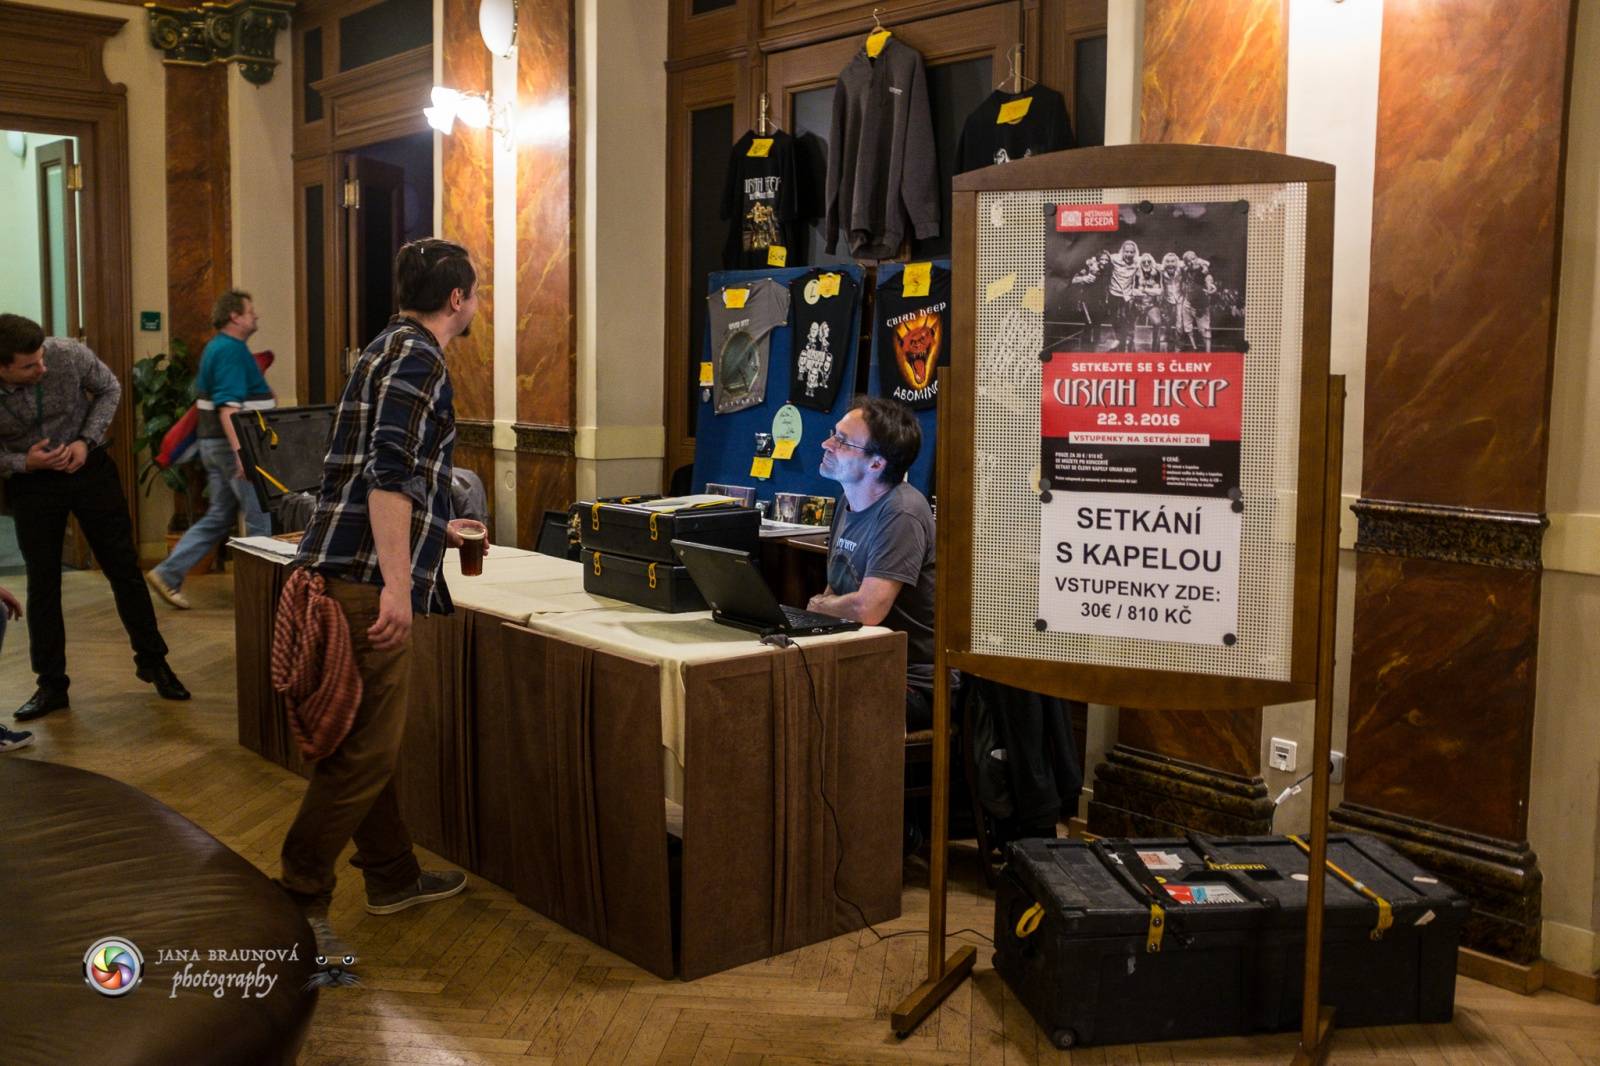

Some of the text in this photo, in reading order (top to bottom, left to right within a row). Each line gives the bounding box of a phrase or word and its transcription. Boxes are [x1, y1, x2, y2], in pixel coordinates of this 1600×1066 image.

[1084, 216, 1114, 226] BESEDA
[1071, 359, 1212, 373] SETKEJTE SE S ČLENY
[1053, 378, 1230, 408] URIAH HEEP
[1073, 434, 1124, 443] VSTUPENKY
[1127, 435, 1140, 443] NA
[1143, 435, 1182, 444] SETKÁNÍ
[1077, 505, 1202, 535] SETKÁNÍ
[1056, 541, 1222, 572] S KAPELOU
[1055, 576, 1221, 602] VSTUPENKY ZDE:
[1081, 602, 1192, 625] 30€ / 810 KČ
